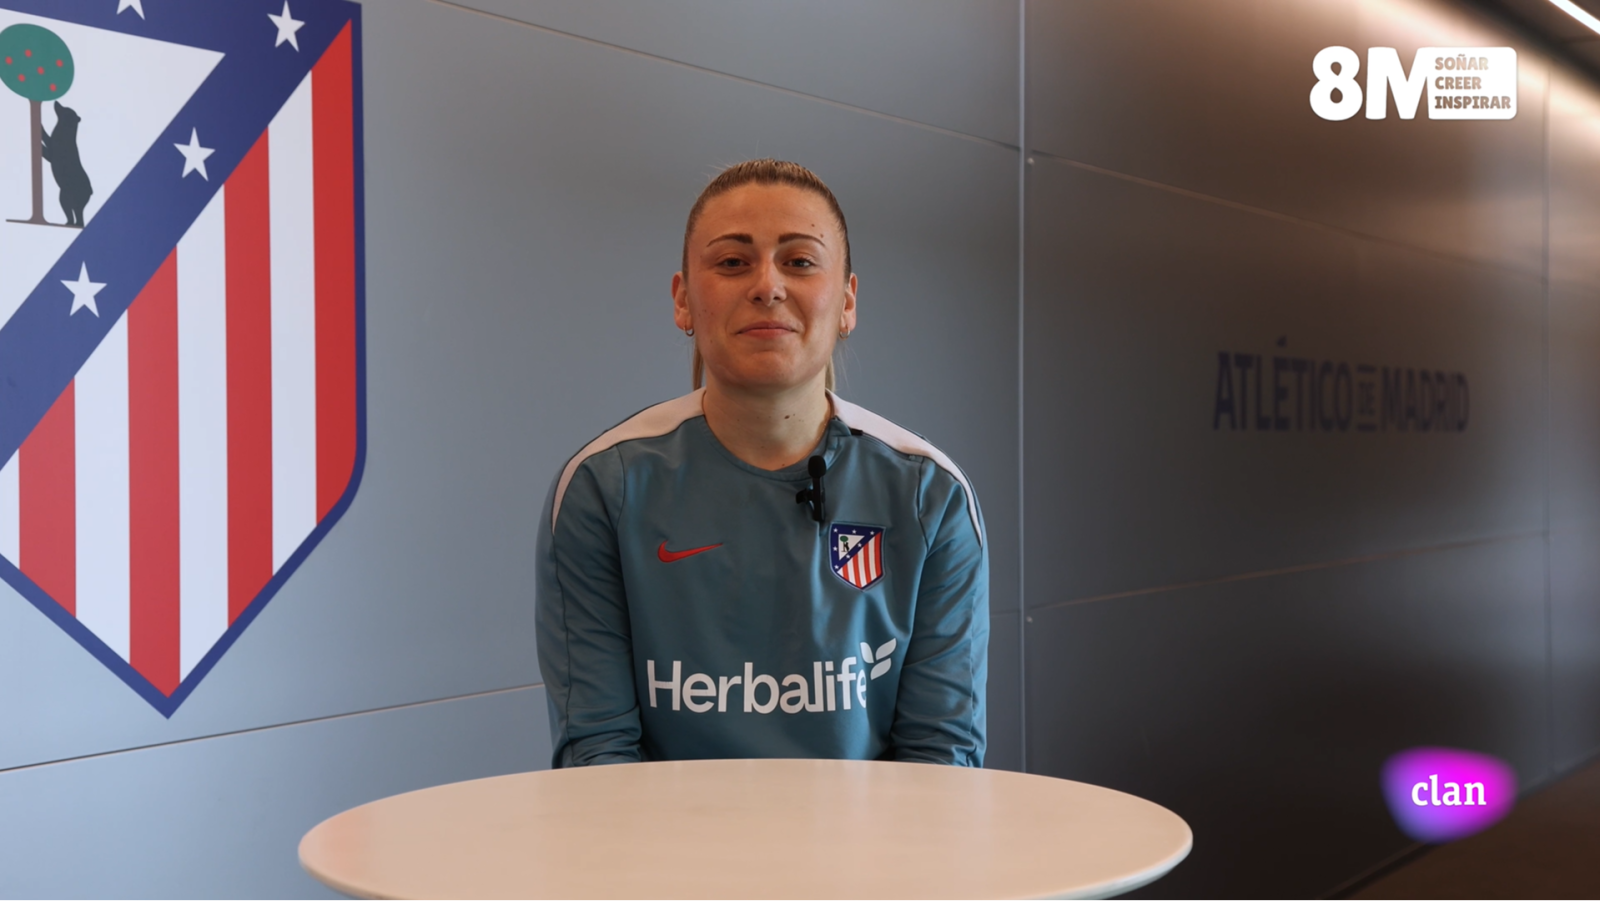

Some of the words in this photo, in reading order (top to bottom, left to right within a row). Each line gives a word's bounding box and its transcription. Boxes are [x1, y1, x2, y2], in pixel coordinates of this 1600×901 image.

[1213, 335, 1353, 431] ATLÉTICO
[1381, 366, 1470, 432] MADRID
[647, 656, 867, 714] Herbalife
